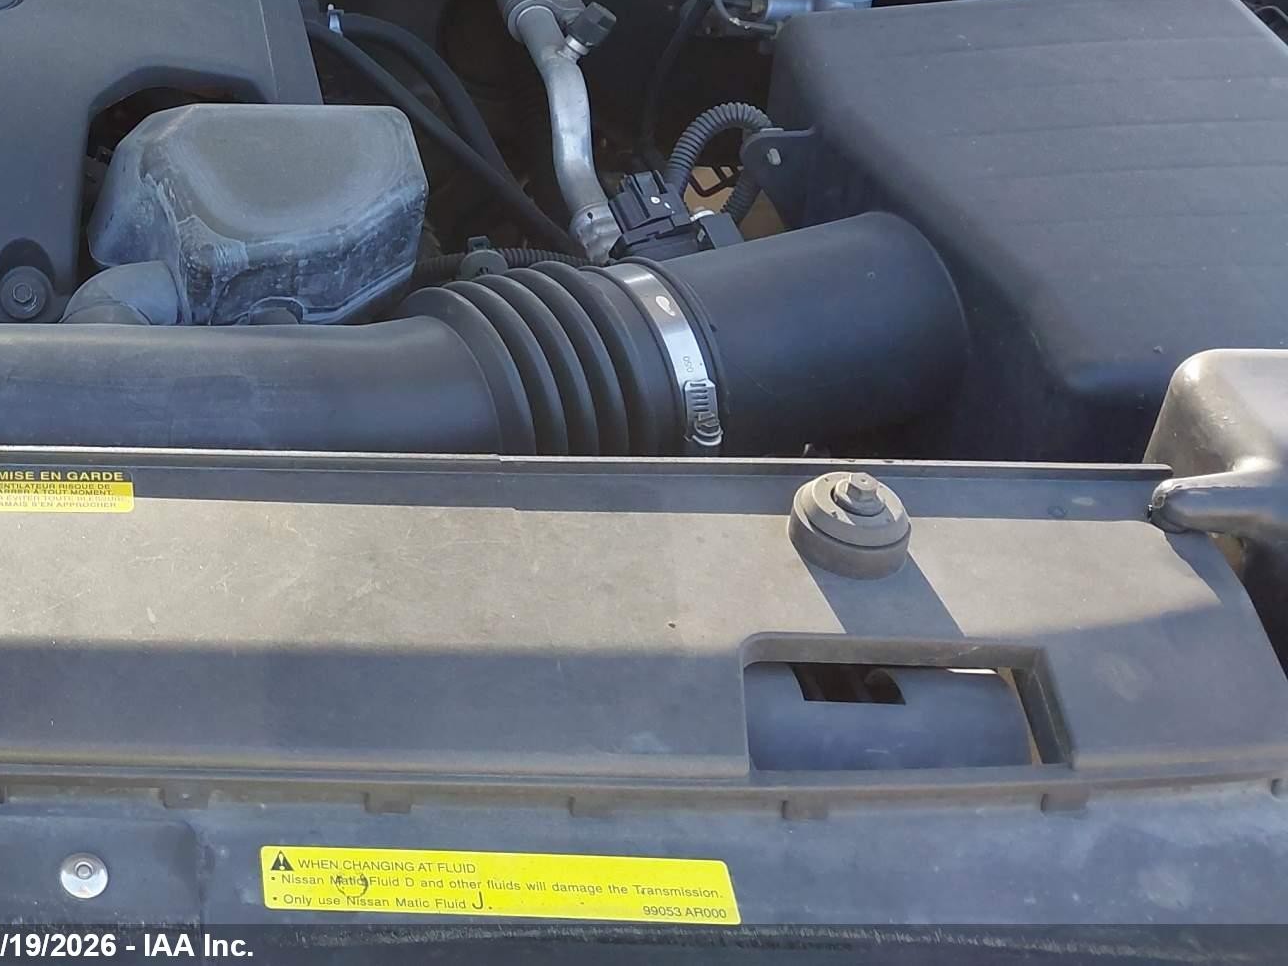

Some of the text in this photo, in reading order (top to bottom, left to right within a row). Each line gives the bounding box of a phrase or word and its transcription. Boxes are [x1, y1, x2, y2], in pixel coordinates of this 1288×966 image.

[40, 471, 62, 481] EN
[66, 471, 124, 481] GARDE
[298, 859, 476, 874] WHEN CHANGING AT FLUID
[281, 874, 724, 899] Nissan Matic Fluid D and other fluids will damage the Transmission.
[283, 894, 312, 907] Only
[318, 897, 341, 906] use
[346, 896, 390, 907] Nissan
[395, 897, 430, 908] Matic
[435, 898, 466, 909] Fluid
[643, 905, 727, 919] 99053 AR000
